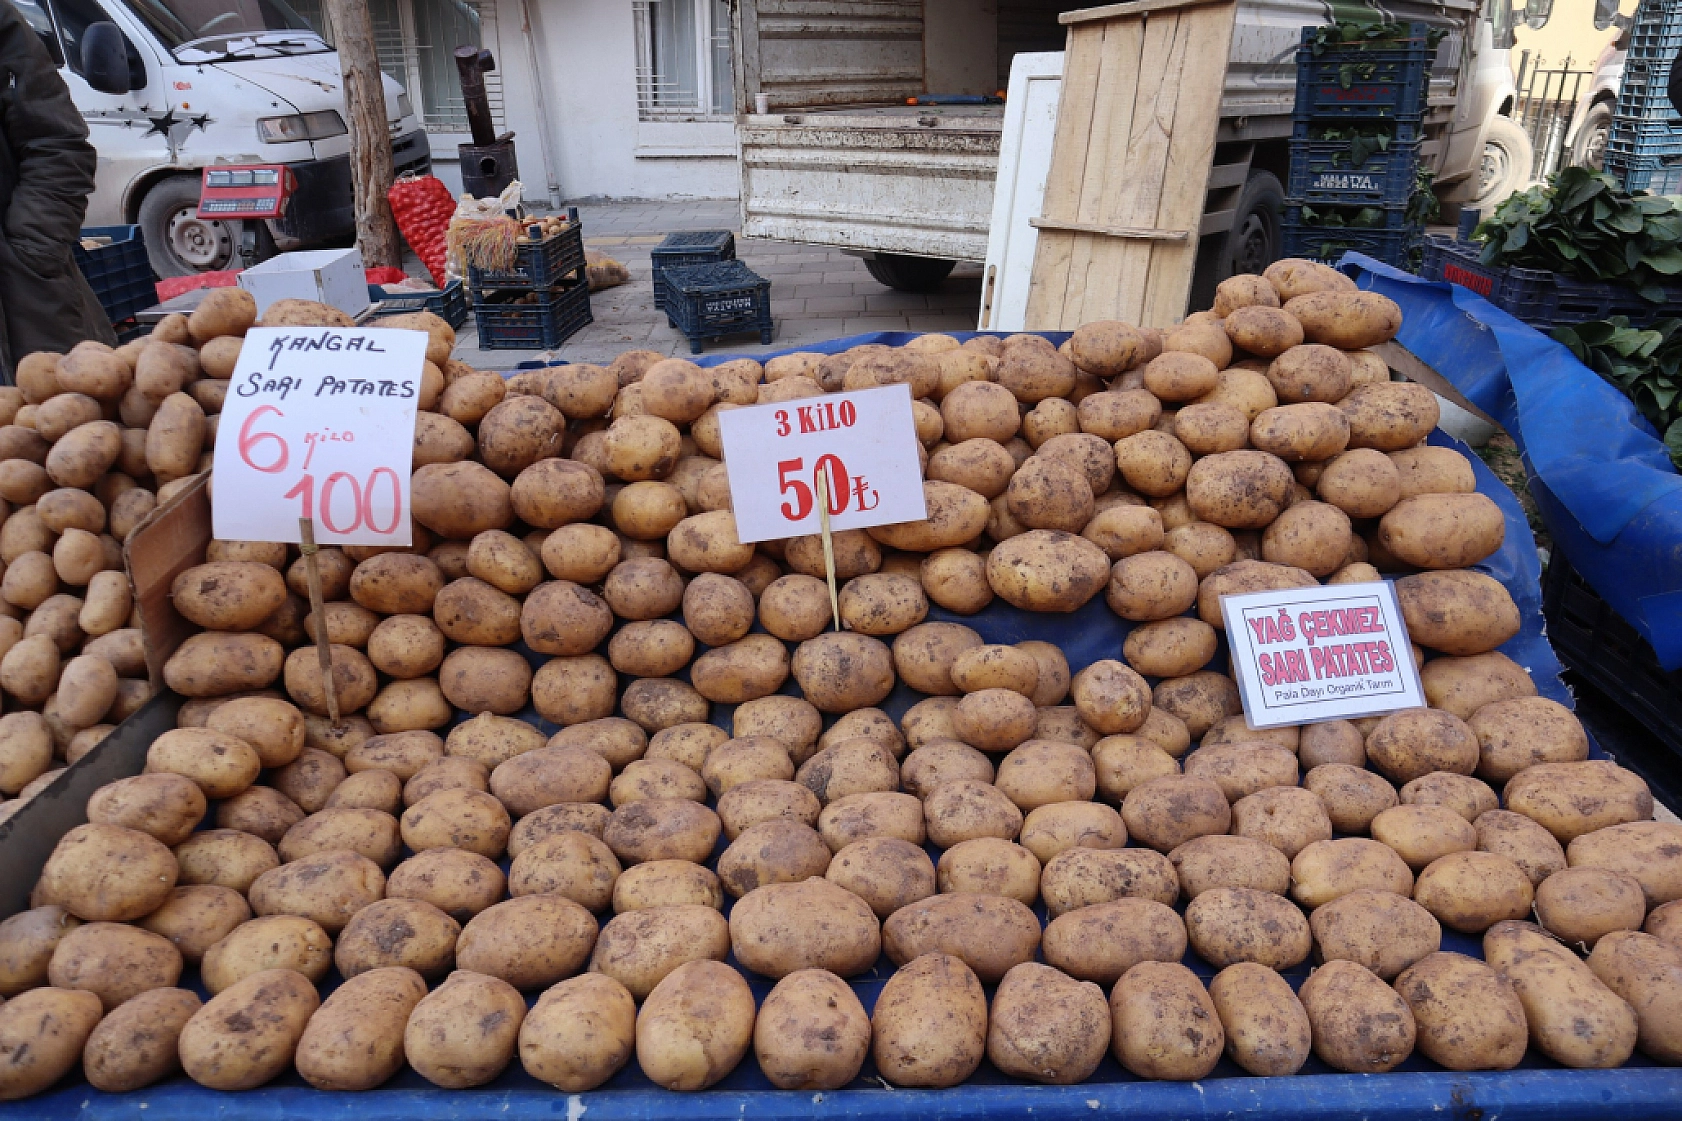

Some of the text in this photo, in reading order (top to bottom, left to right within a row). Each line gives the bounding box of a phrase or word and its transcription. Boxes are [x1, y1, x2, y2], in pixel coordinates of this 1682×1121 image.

[268, 331, 386, 371] KANGAL
[314, 375, 415, 398] PATATES
[238, 404, 290, 474] 6
[774, 409, 792, 437] 3
[283, 466, 402, 535] 100
[1247, 605, 1385, 646] YAĞ ÇEKMEZ
[1258, 640, 1395, 687] SARI PATATES
[1274, 689, 1299, 701] Pala
[1326, 678, 1366, 696] Organik
